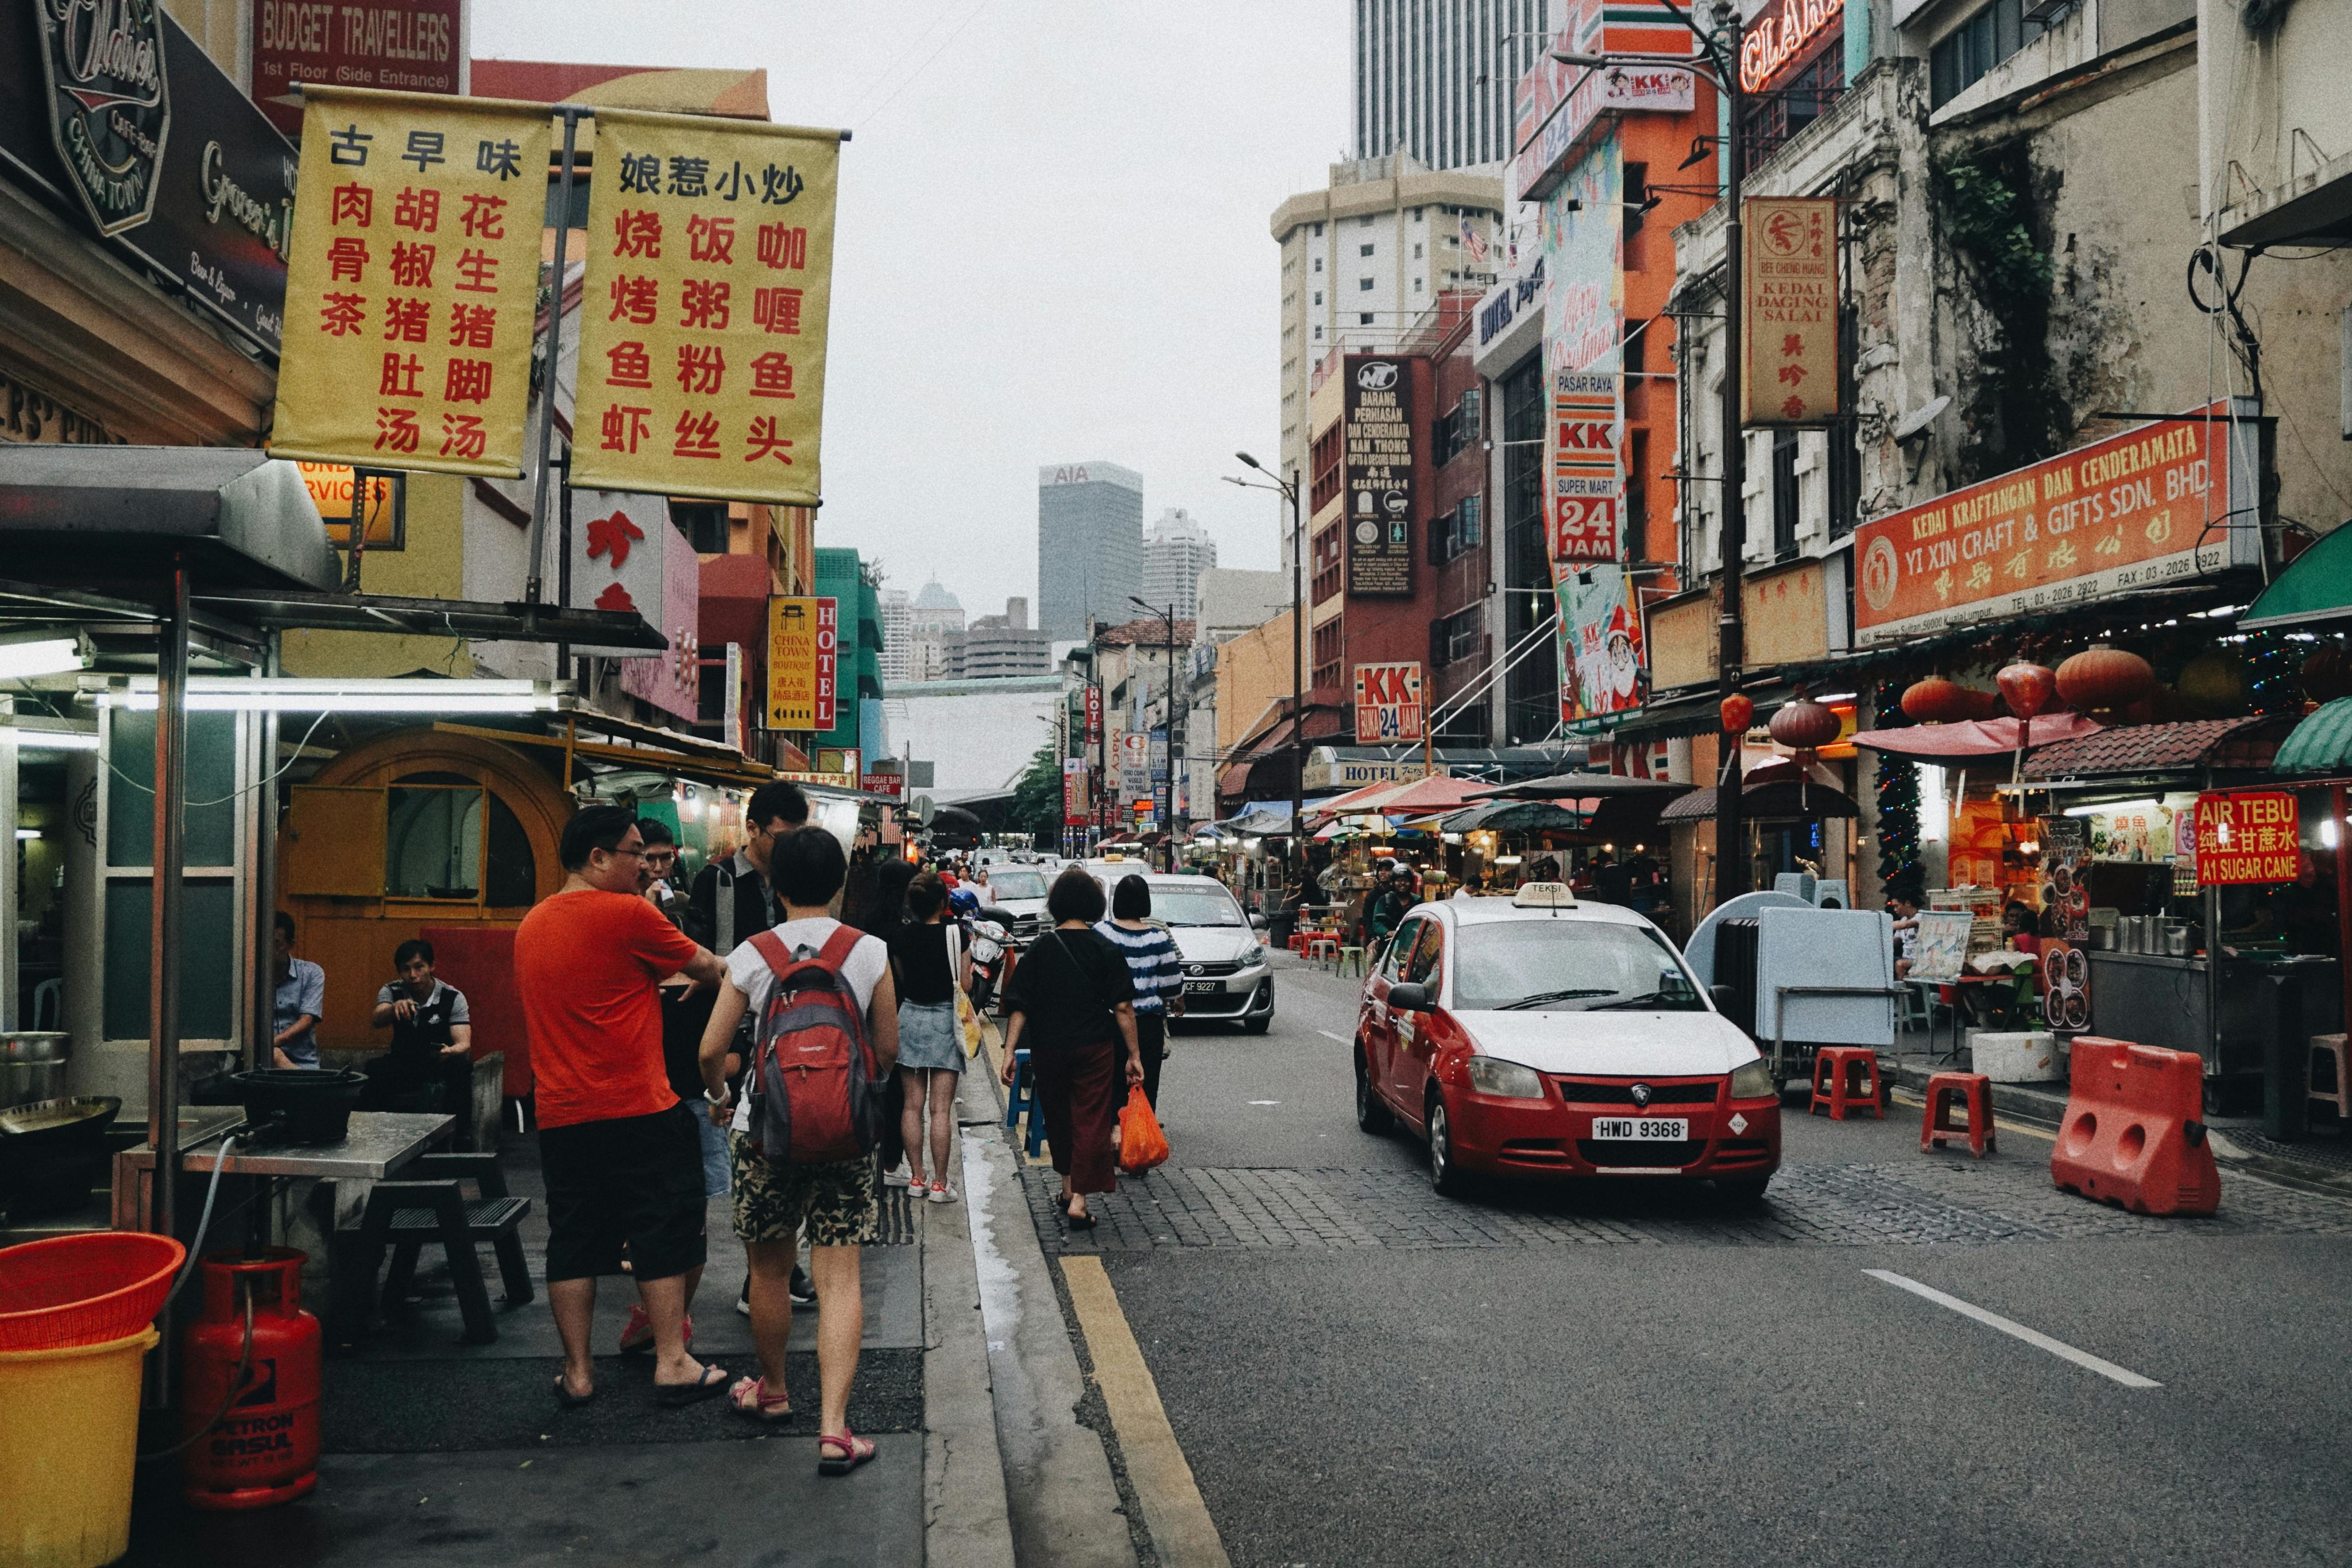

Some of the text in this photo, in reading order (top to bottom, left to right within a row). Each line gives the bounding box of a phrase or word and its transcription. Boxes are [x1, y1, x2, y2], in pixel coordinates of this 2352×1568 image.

[262, 0, 450, 62] BUDGET TRAVELLERS
[262, 61, 450, 90] 1st Floor (Side Entrance)
[1635, 74, 1664, 89] KK
[330, 124, 521, 181] 古早味
[283, 156, 297, 196] HO
[620, 152, 804, 205] 娘惹小炒
[320, 181, 373, 336] 肉骨茶
[1761, 262, 1825, 274] BEE CHENG HIANG
[1763, 282, 1823, 295] KEDAI
[1757, 296, 1828, 308] DAGING
[373, 186, 441, 454] 胡椒猪肚汤
[439, 193, 508, 459] 花生猪脚汤
[1480, 287, 1512, 345] HOTEL
[1765, 310, 1823, 322] SALAI
[601, 208, 663, 454] 烧烤鱼虾
[673, 214, 735, 460] 饭粥粉丝
[744, 222, 807, 466] 咖喱鱼头
[1558, 376, 1612, 393] PASAR RAYA
[1361, 392, 1396, 406] BARANG
[1355, 408, 1403, 422] PERHIASAN
[1348, 423, 1410, 438] DAN CENDERAMATA
[1559, 423, 1614, 449] KK
[1350, 439, 1408, 452] NAN THONG
[1348, 454, 1363, 466] GIFTS
[1368, 454, 1389, 466] DECORS
[1401, 454, 1411, 466] BHD
[1054, 466, 1089, 484] AIA
[1558, 479, 1613, 494] SUPER MART
[1912, 424, 2198, 541] KEDAI KRAFTANGAN DAN CENDERAMATA
[1561, 500, 1612, 536] 24
[1905, 459, 2214, 576] YI XIN CRAFT & GIFTS SDN. BHD.
[1562, 539, 1612, 556] JAM
[2118, 571, 2136, 587] FAX
[2145, 567, 2157, 580] 03
[2166, 558, 2189, 575] 2026
[2011, 580, 2098, 611] TEL 03 2026 2922
[774, 634, 810, 646] CHINA
[775, 646, 809, 656] TOWN
[773, 660, 811, 671] BOUTIQUE
[818, 607, 835, 720] HOTEL
[777, 676, 806, 688] 唐人街
[1364, 667, 1412, 704] KK
[773, 690, 810, 701] 精品酒店
[1089, 689, 1099, 744] HOTEL
[1360, 707, 1419, 738] BUKA 24 JAM
[1111, 728, 1120, 772] Macy
[1611, 741, 1651, 780] KK
[863, 775, 901, 784] REGGAE BAR
[1345, 766, 1399, 781] HOTEL
[873, 784, 891, 793] CAFE
[2114, 815, 2148, 832] 燒魚
[2199, 798, 2293, 826] AIR TEBU
[2199, 824, 2297, 854] 纯正甘蔗水
[2202, 855, 2297, 881] A1 SUGAR CANE
[1532, 884, 1561, 892] TEKSI
[1197, 982, 1216, 992] 9227
[1600, 1121, 1681, 1137] HWD 9368
[210, 1412, 294, 1436] PETRON
[210, 1433, 294, 1457] GASUL
